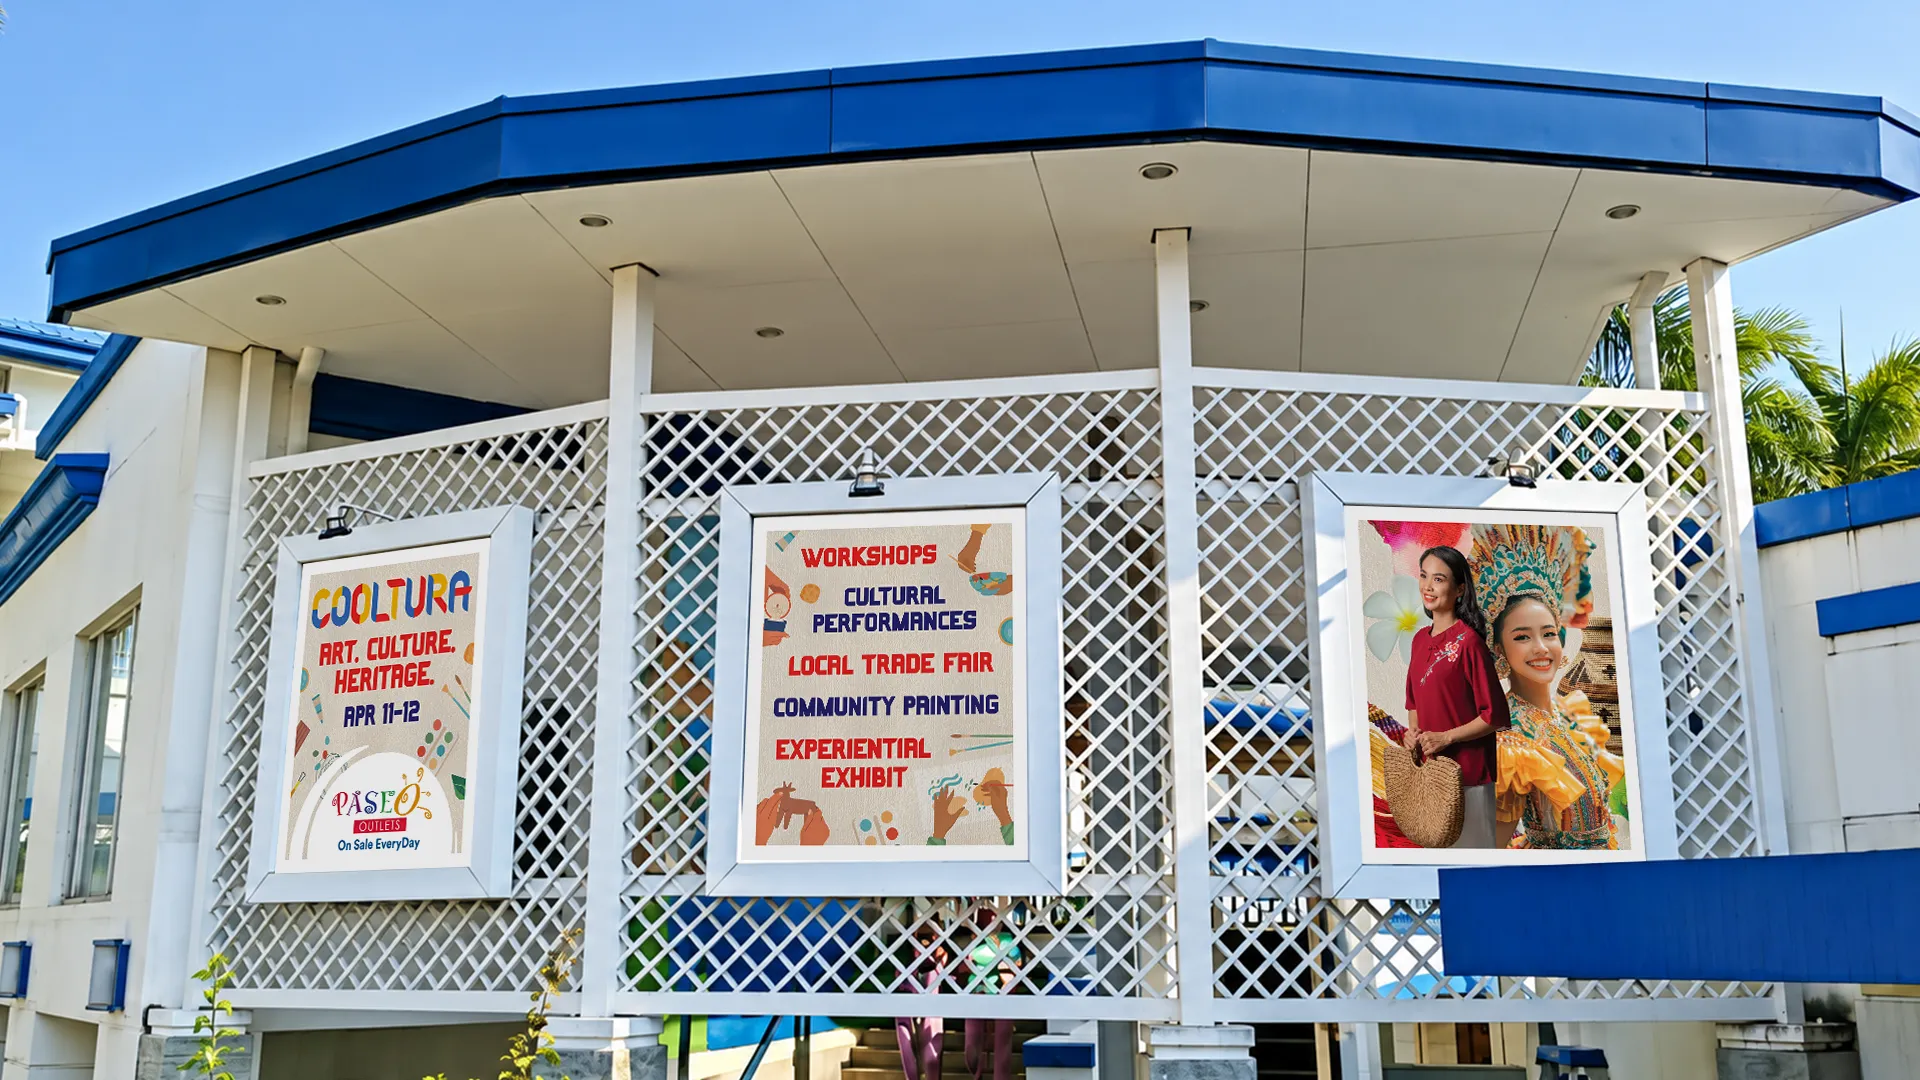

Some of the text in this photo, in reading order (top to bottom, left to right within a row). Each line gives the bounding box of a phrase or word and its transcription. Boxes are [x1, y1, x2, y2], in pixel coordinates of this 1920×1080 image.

[801, 544, 937, 568] WORKSHOPS
[311, 570, 473, 629] COOLTURA
[844, 585, 946, 606] CULTURAL
[812, 610, 977, 633] PERFORMANCES
[319, 628, 456, 666] ART. CULTURE.
[788, 652, 994, 676] LOCAL TRADE FAIR
[334, 660, 435, 694] HERITAGE.
[343, 700, 420, 728] APR 11-12
[773, 694, 999, 717] COMMUNITY PAINTING
[776, 738, 931, 760] EXPERIENTIAL
[821, 766, 908, 788] EXHIBIT
[331, 781, 432, 819] PASEO
[358, 819, 401, 832] OUTLETS
[337, 837, 421, 851] On Sale EveryDay
